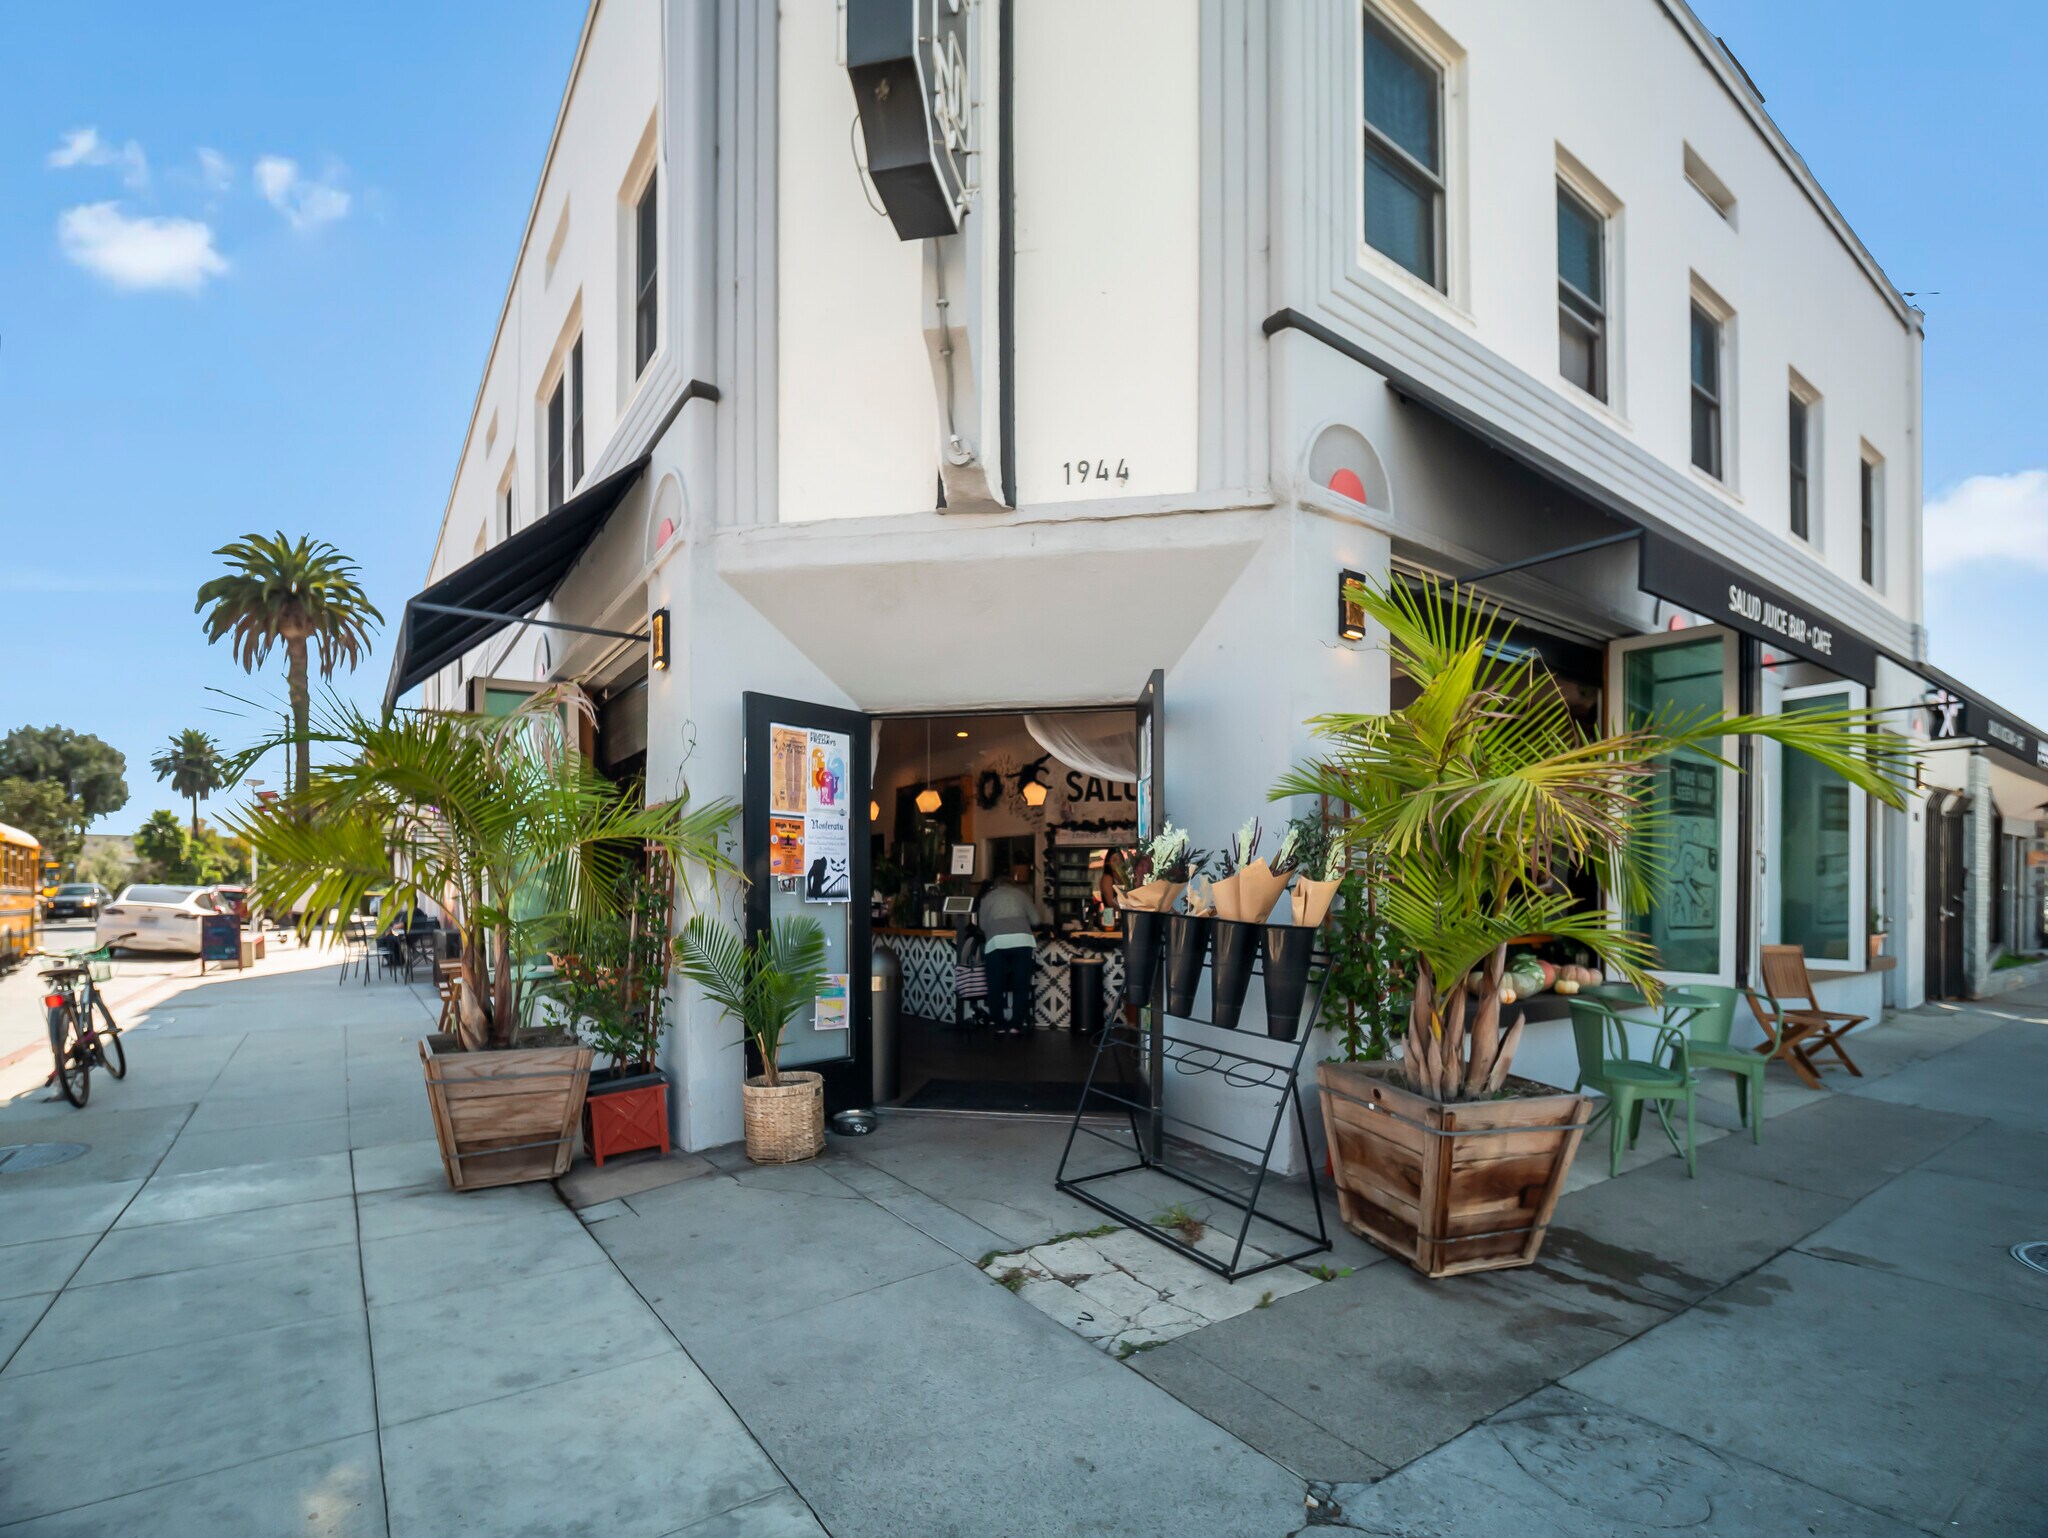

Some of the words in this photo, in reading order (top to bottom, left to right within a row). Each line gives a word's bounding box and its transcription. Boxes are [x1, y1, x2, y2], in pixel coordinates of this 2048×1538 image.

[1063, 458, 1129, 485] 1944
[1728, 584, 1762, 622] SALUD
[1761, 601, 1788, 635] JUICE
[1788, 613, 1807, 643] BAR
[810, 737, 837, 746] FRIDAYS
[811, 819, 844, 832] Nosferatu
